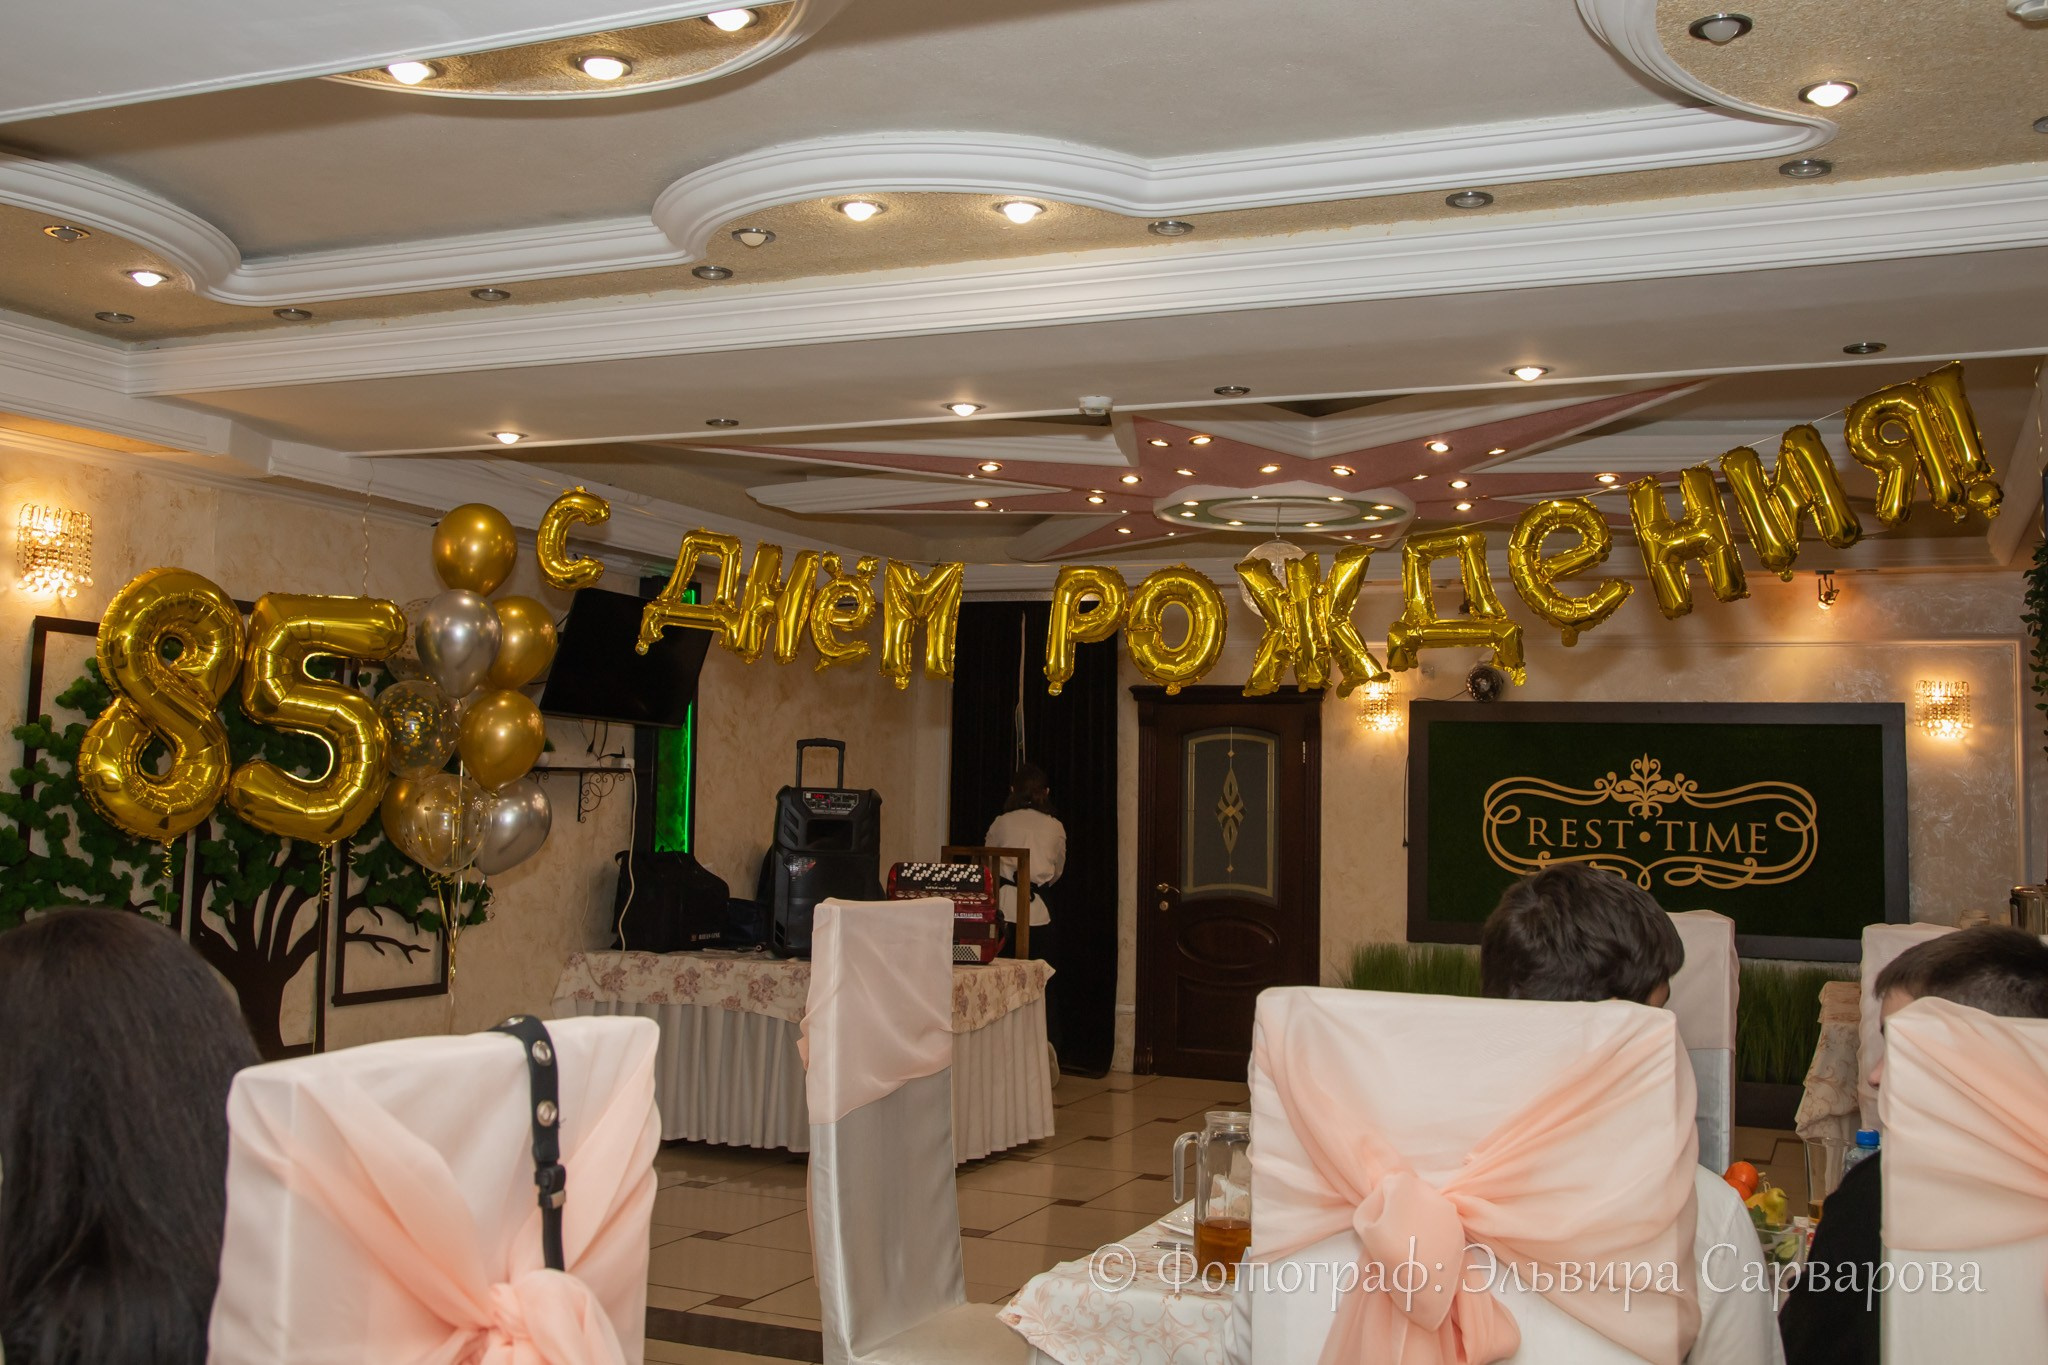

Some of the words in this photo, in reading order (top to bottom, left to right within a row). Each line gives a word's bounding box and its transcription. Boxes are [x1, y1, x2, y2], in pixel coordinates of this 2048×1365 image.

[78, 567, 407, 843] 85
[1527, 817, 1634, 849] REST
[1656, 820, 1768, 854] TIME
